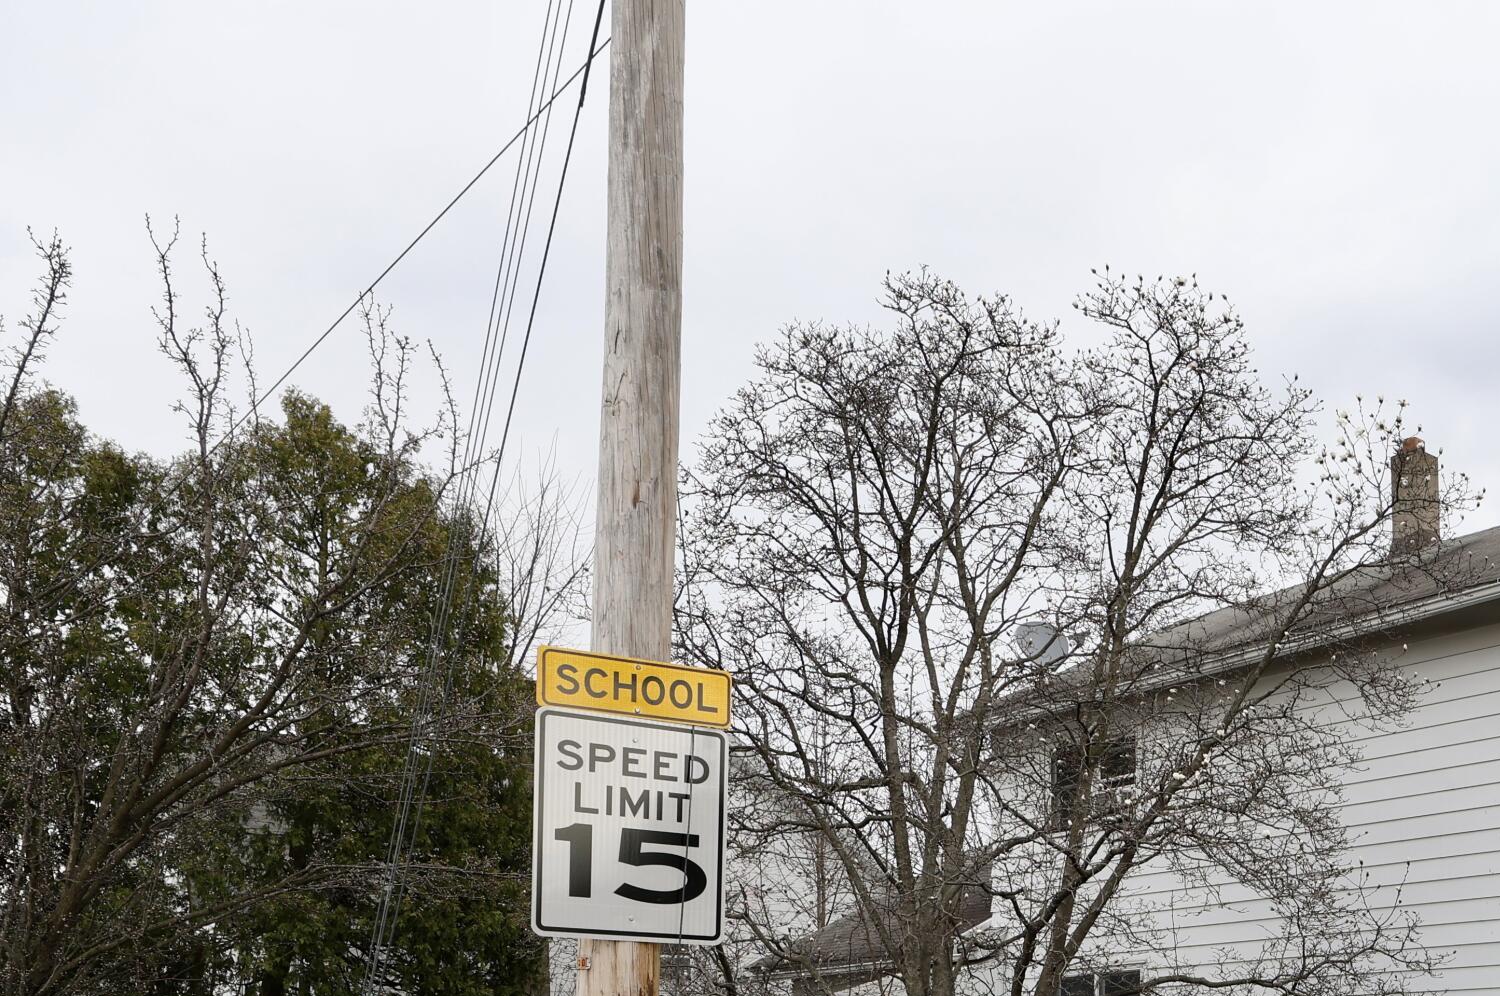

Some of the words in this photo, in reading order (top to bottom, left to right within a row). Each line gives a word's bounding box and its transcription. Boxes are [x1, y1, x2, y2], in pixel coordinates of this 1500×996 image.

[555, 663, 719, 714] SCHOOL
[556, 739, 711, 785] SPEED
[573, 781, 691, 823] LIMIT
[554, 822, 708, 905] 15
